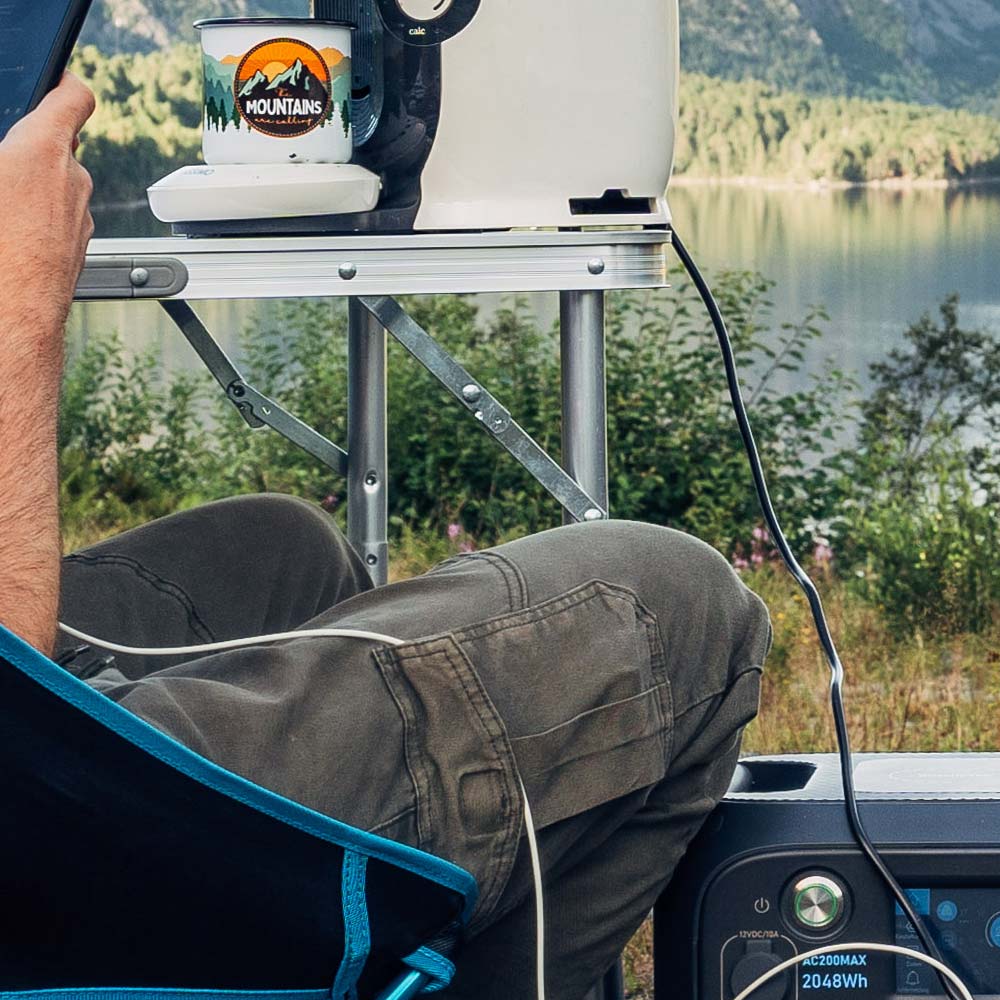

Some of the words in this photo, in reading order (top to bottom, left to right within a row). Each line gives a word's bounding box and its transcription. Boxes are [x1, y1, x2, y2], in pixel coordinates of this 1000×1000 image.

[246, 98, 322, 115] MOUNTAINS
[802, 954, 867, 966] AC200MAX
[802, 974, 868, 989] 2048Wh
